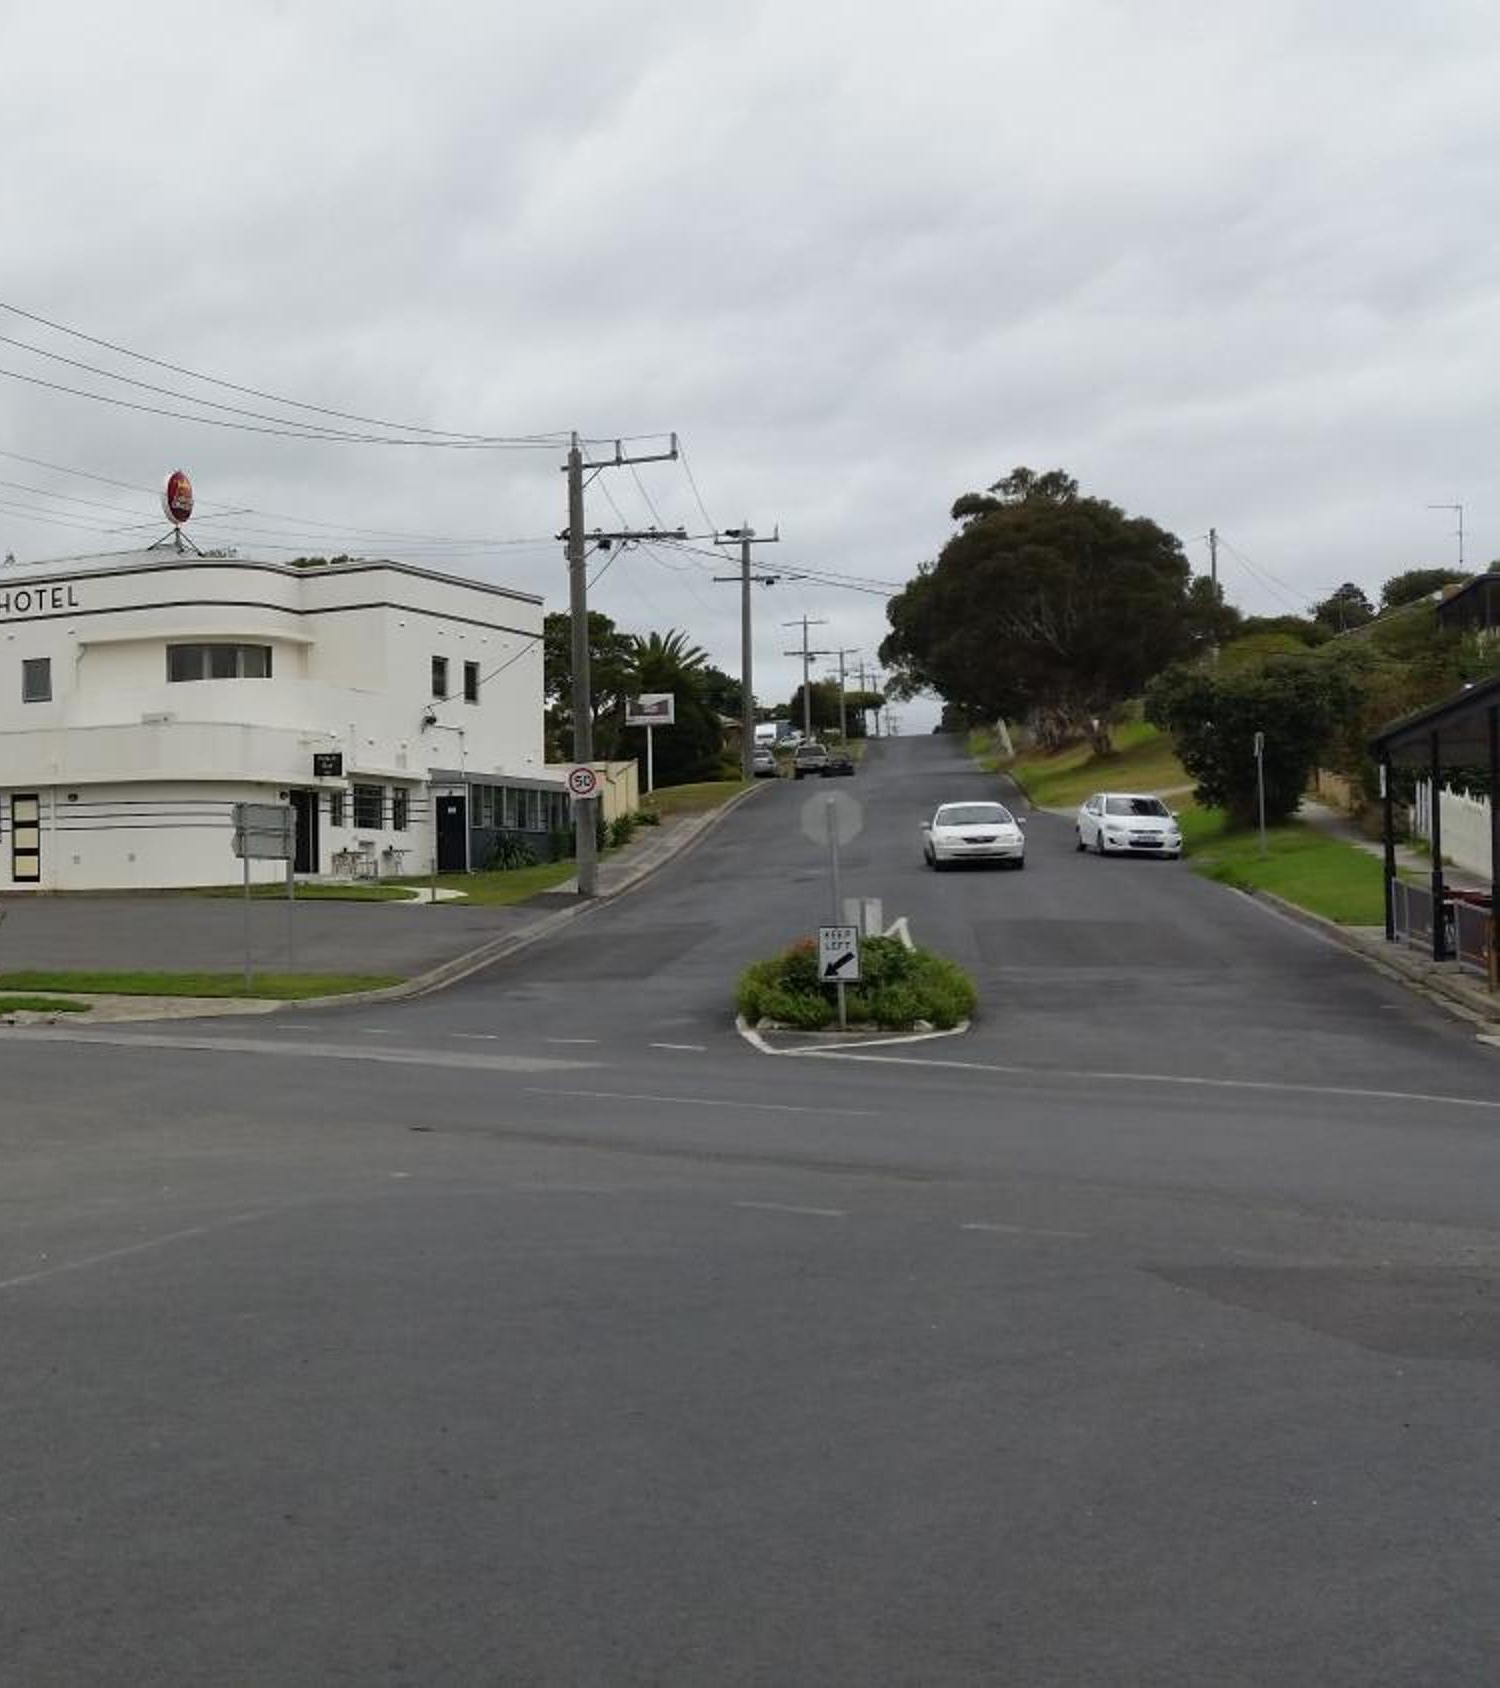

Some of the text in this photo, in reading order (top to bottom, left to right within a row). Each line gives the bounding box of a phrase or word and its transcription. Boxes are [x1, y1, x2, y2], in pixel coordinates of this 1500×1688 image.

[574, 775, 592, 787] 50
[824, 929, 851, 939] KEEP
[825, 941, 851, 951] LEFT
